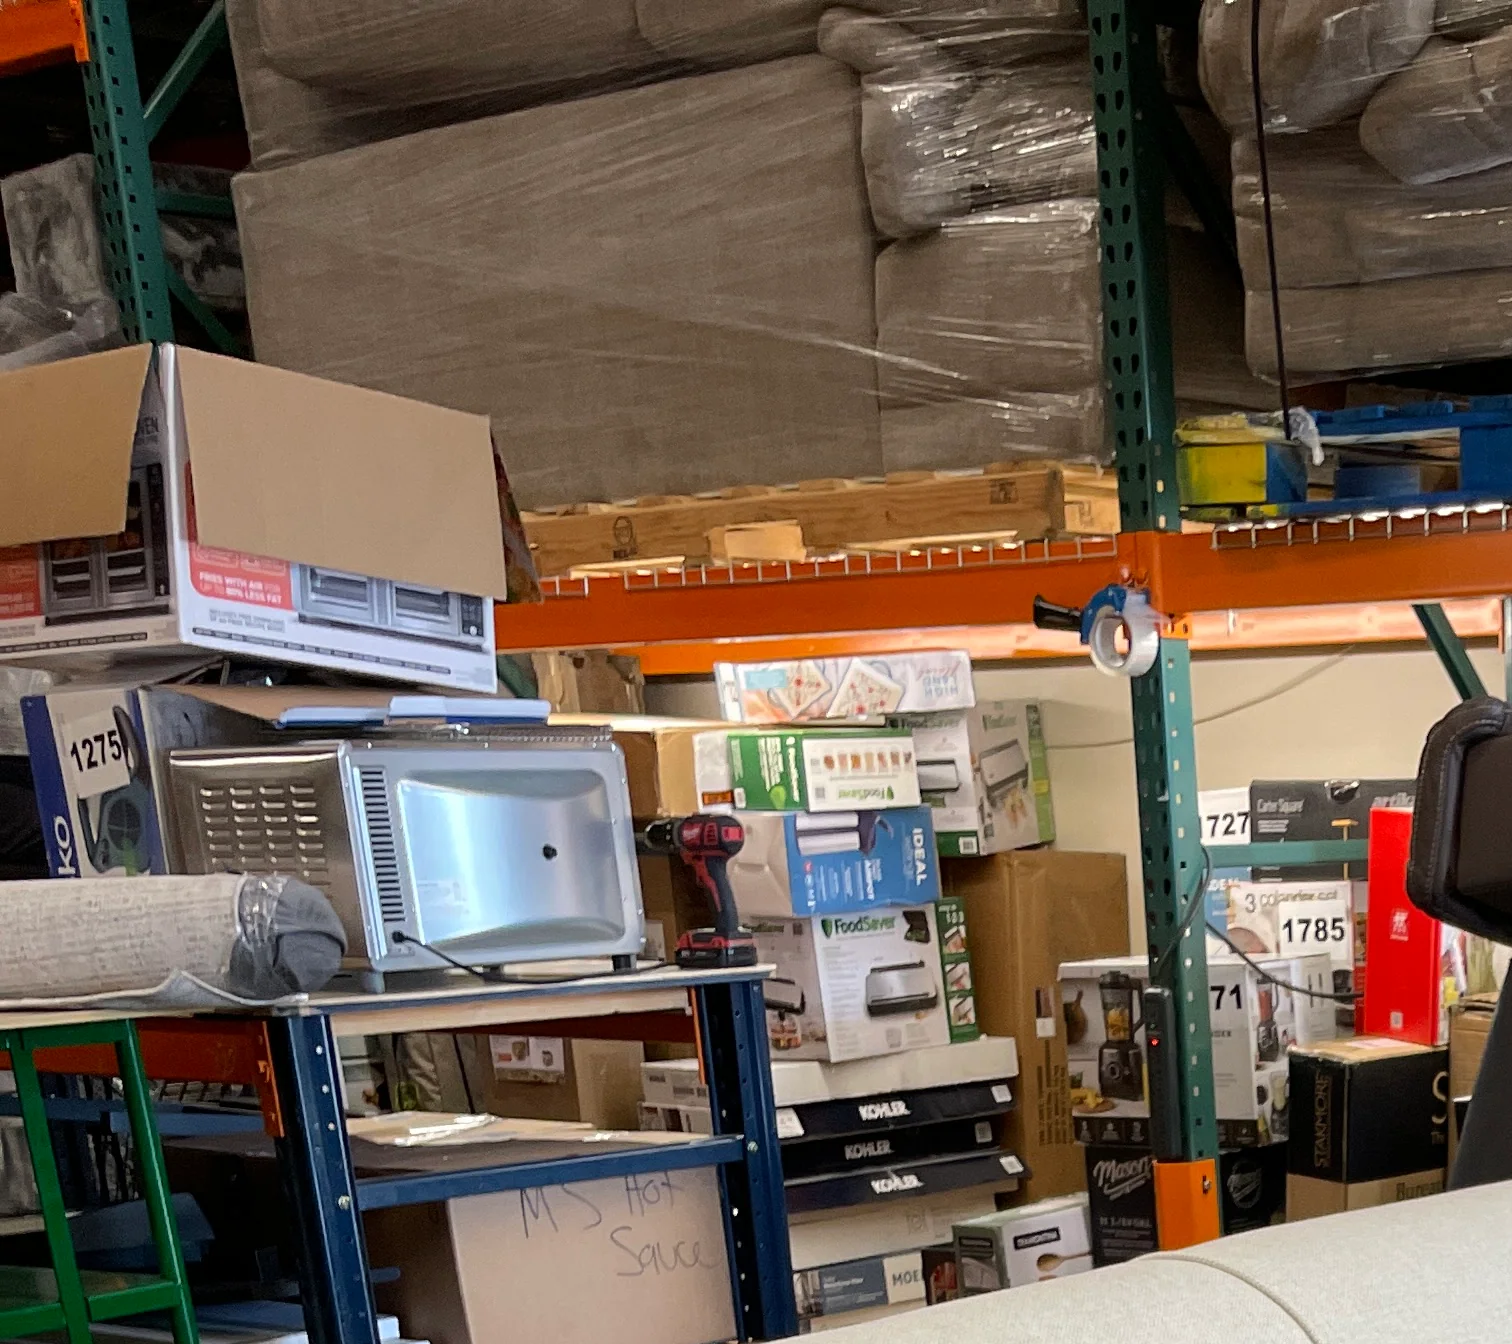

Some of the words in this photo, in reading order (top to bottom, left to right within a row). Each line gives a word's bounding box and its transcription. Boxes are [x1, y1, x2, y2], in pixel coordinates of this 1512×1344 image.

[70, 729, 123, 773] 1275
[1200, 811, 1250, 838] 727
[912, 828, 927, 887] IDEAL
[1244, 893, 1257, 914] 3
[834, 914, 896, 934] FoodSaver
[1281, 917, 1346, 943] 1785
[858, 1101, 911, 1121] KOHLER
[845, 1140, 895, 1161] KOHLER
[871, 1175, 924, 1195] KOHLER
[609, 1225, 721, 1277] Sauce
[891, 1268, 922, 1287] MOE
